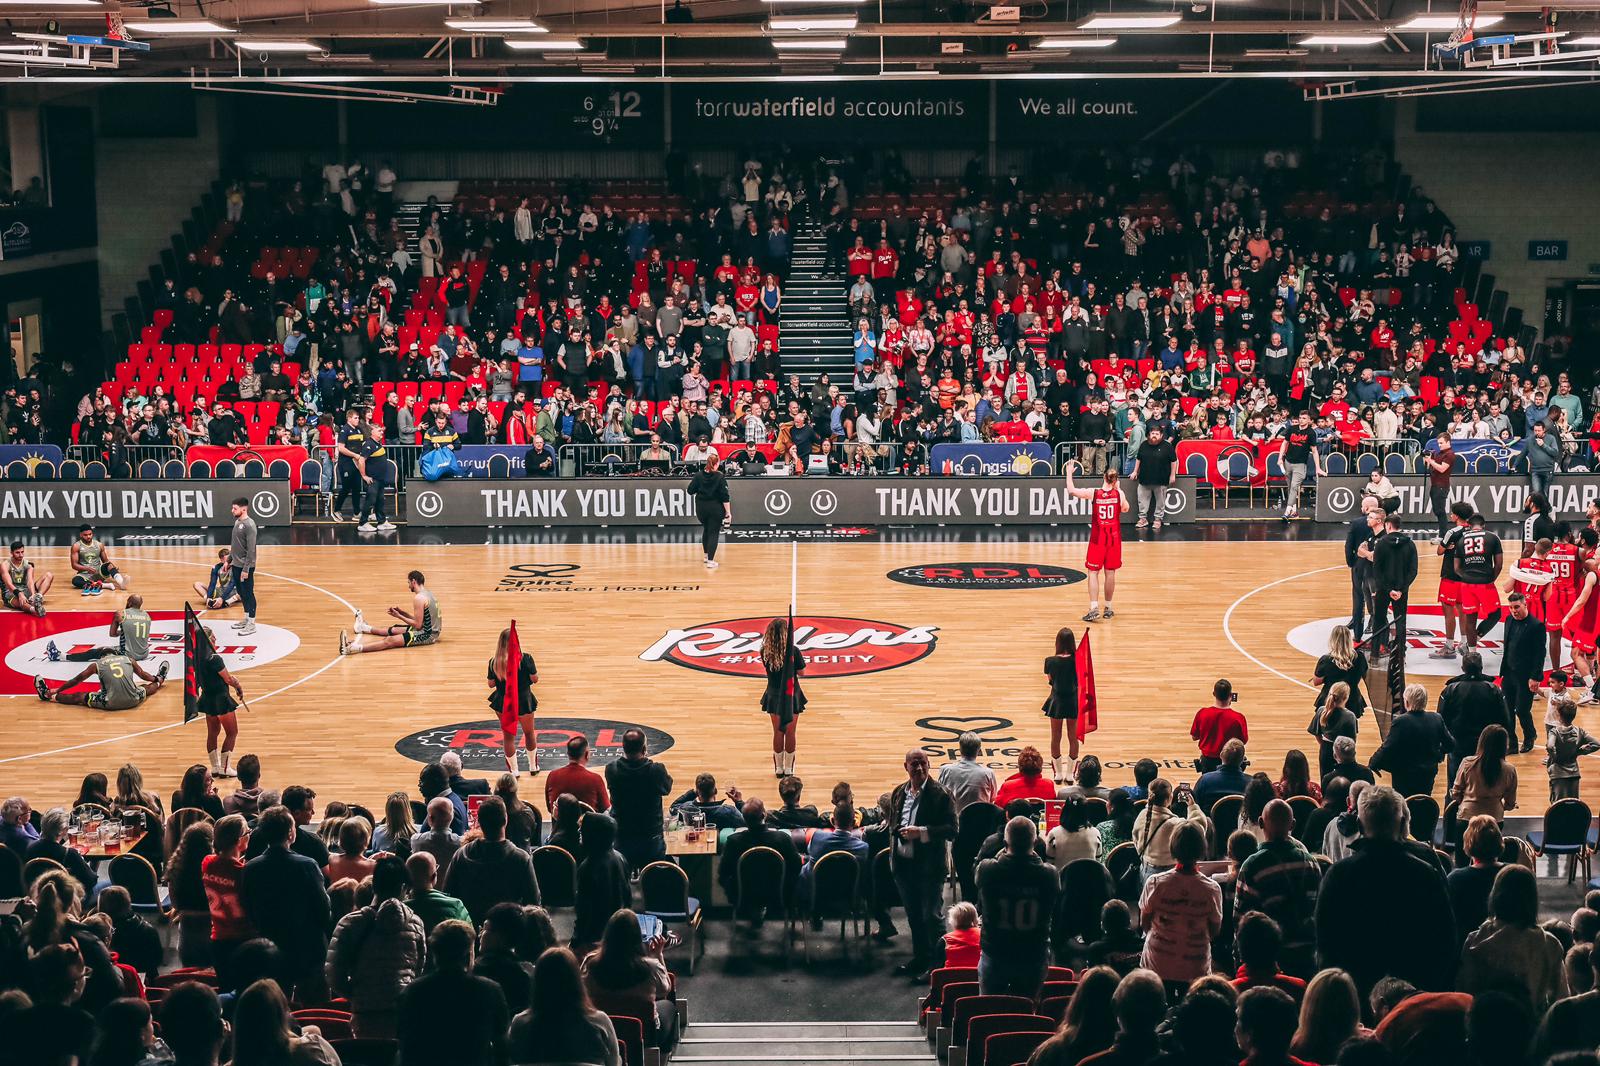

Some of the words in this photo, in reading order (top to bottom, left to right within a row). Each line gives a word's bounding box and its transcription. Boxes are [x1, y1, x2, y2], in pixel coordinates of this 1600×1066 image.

[584, 96, 593, 111] 6
[608, 91, 641, 117] 12
[696, 96, 835, 117] torrwaterfield
[843, 98, 964, 116] accountants
[1019, 97, 1051, 115] We
[1056, 97, 1076, 115] all
[1082, 102, 1138, 115] count.
[592, 118, 604, 135] 9
[1536, 245, 1559, 256] BAR
[1, 490, 55, 519] ANK
[62, 490, 113, 519] YOU
[121, 490, 214, 518] DARIEN
[480, 488, 568, 518] THANK
[575, 488, 625, 517] YOU
[635, 488, 697, 517] DARI
[875, 487, 962, 516] THANK
[970, 487, 1020, 516] YOU
[1029, 487, 1093, 516] DARI
[1397, 485, 1480, 514] THNK
[1098, 505, 1114, 519] 50
[1464, 536, 1486, 555] 23
[923, 567, 1066, 579] RDL
[499, 579, 574, 587] Spire
[133, 621, 147, 639] 11
[718, 655, 876, 664] #KGCITY
[109, 662, 124, 679] 5
[449, 728, 624, 748] RDL
